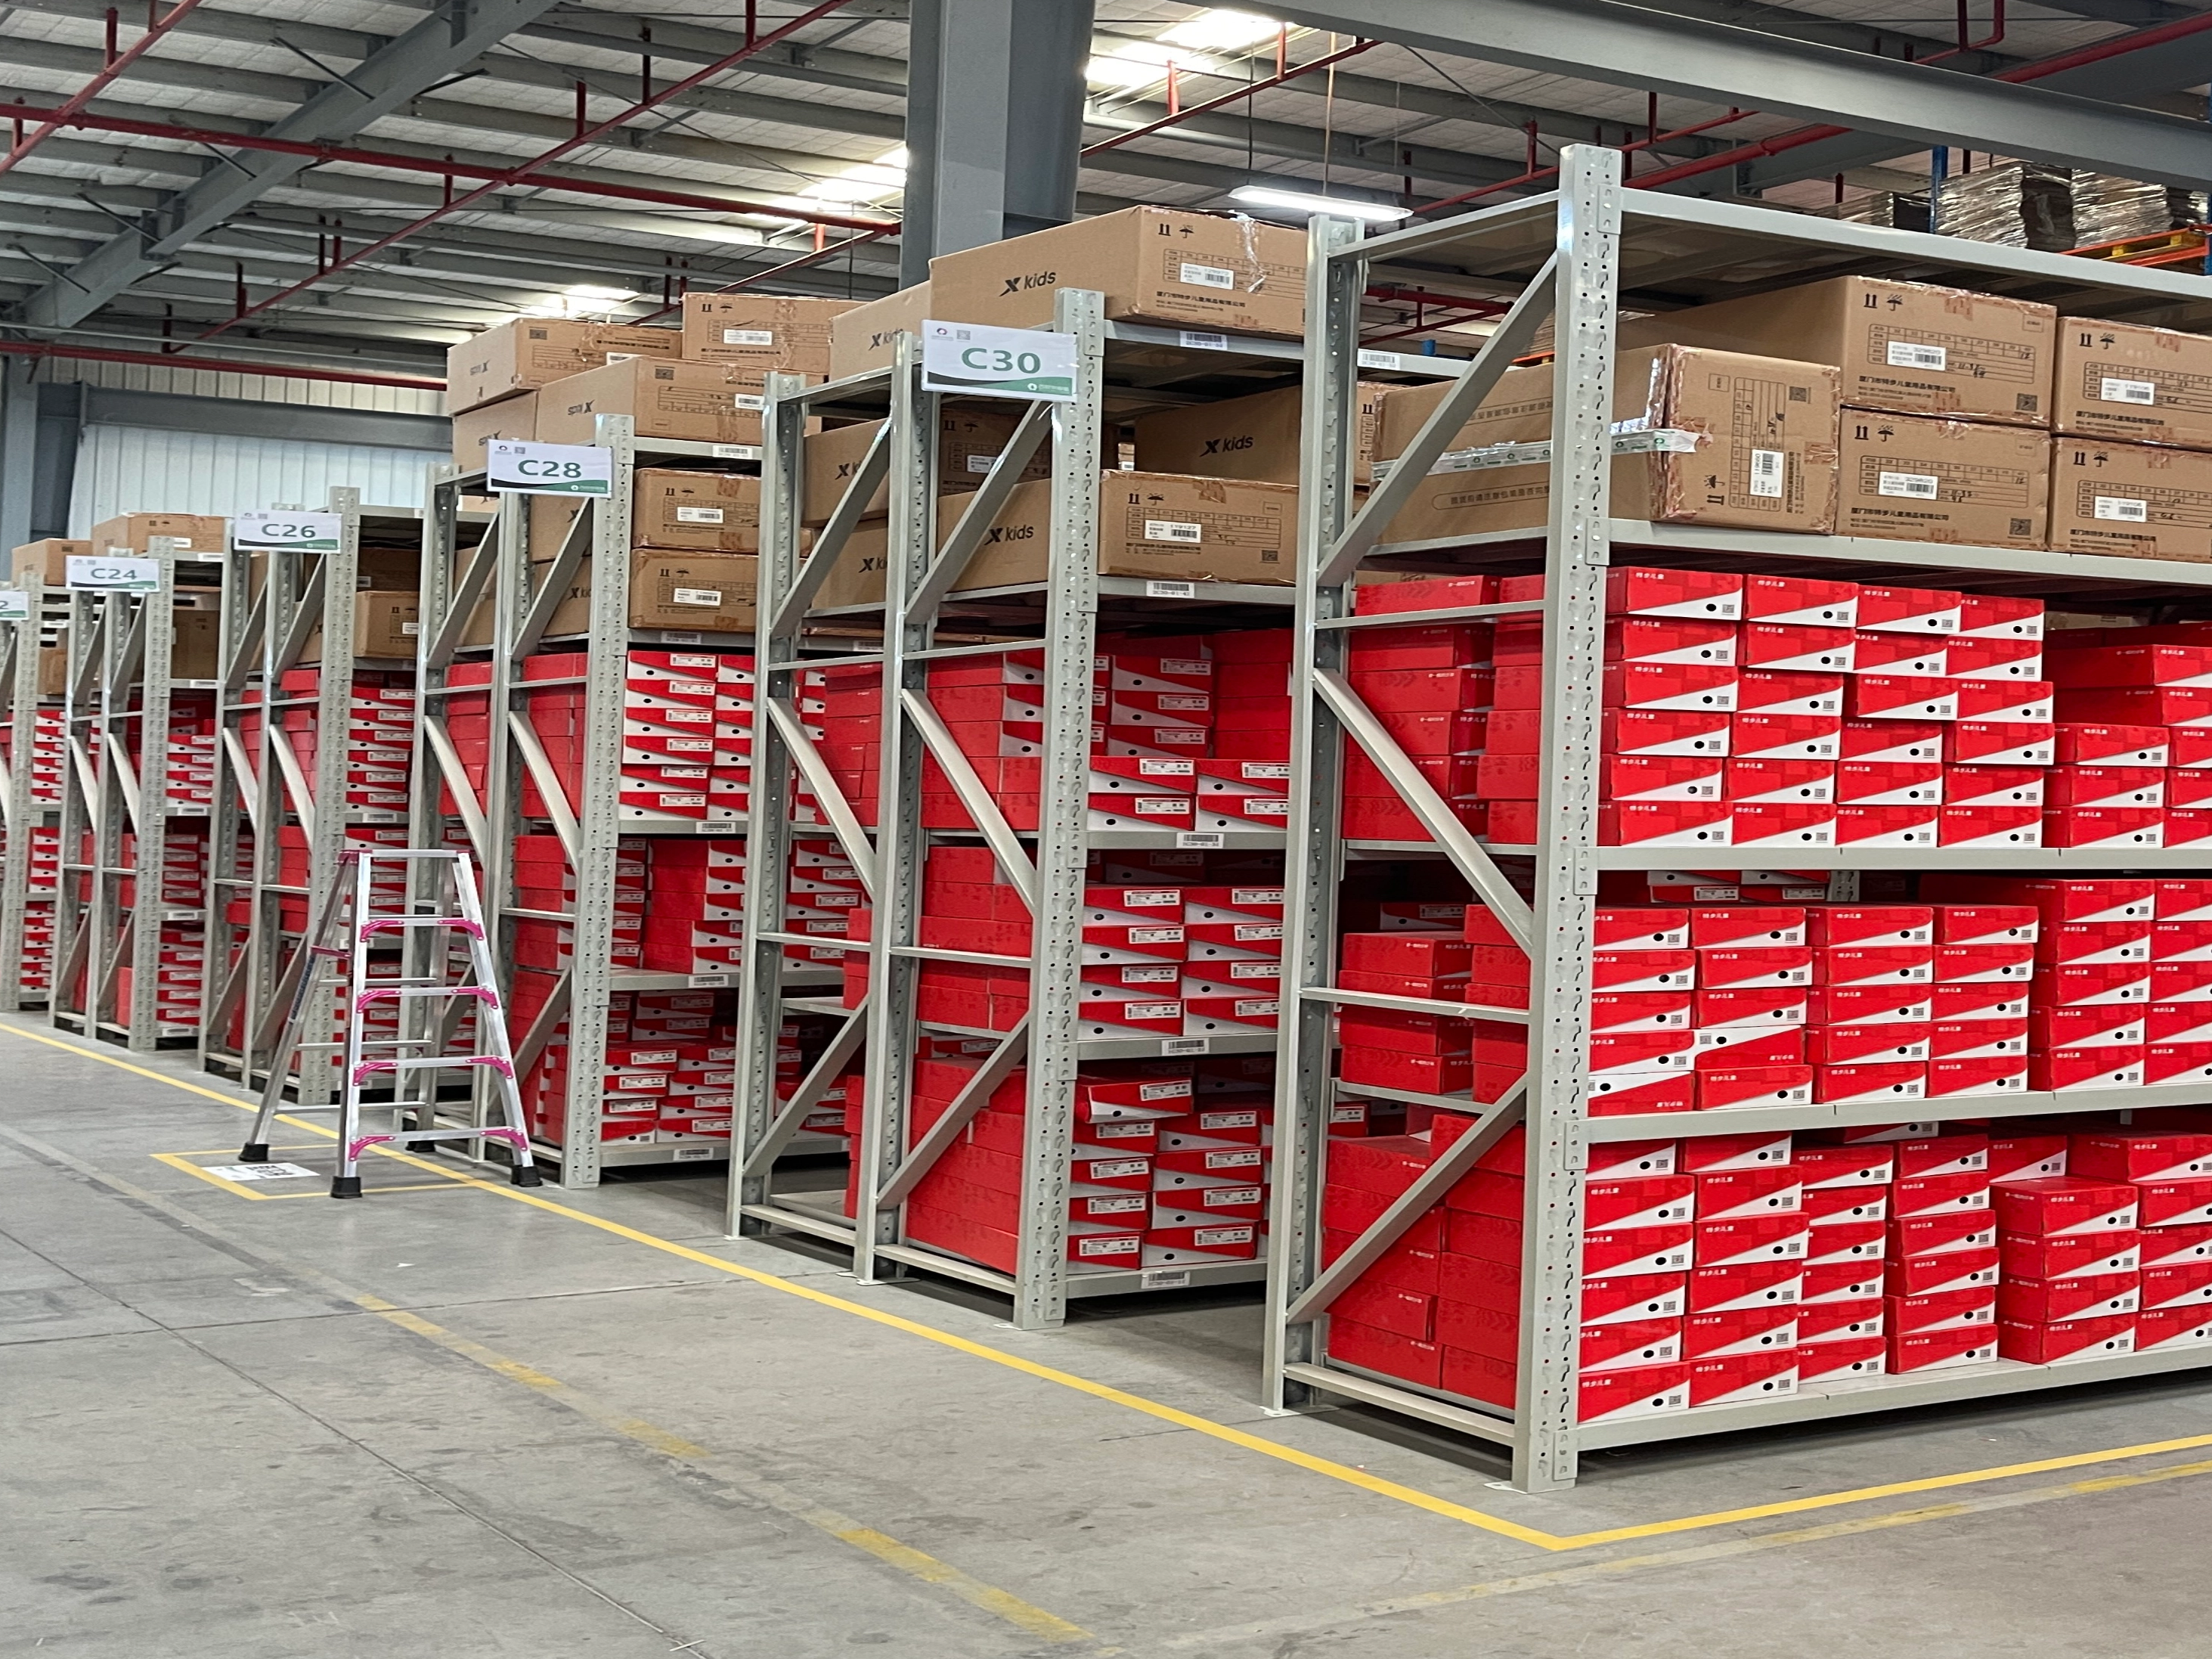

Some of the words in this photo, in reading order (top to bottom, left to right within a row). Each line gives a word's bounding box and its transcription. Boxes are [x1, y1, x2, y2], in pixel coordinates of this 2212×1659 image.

[1024, 271, 1057, 290] kids
[961, 347, 1041, 374] C30
[1222, 436, 1253, 451] kids
[518, 459, 581, 478] C28
[262, 523, 316, 538] C26
[1005, 526, 1034, 542] kids
[91, 568, 138, 580] C24
